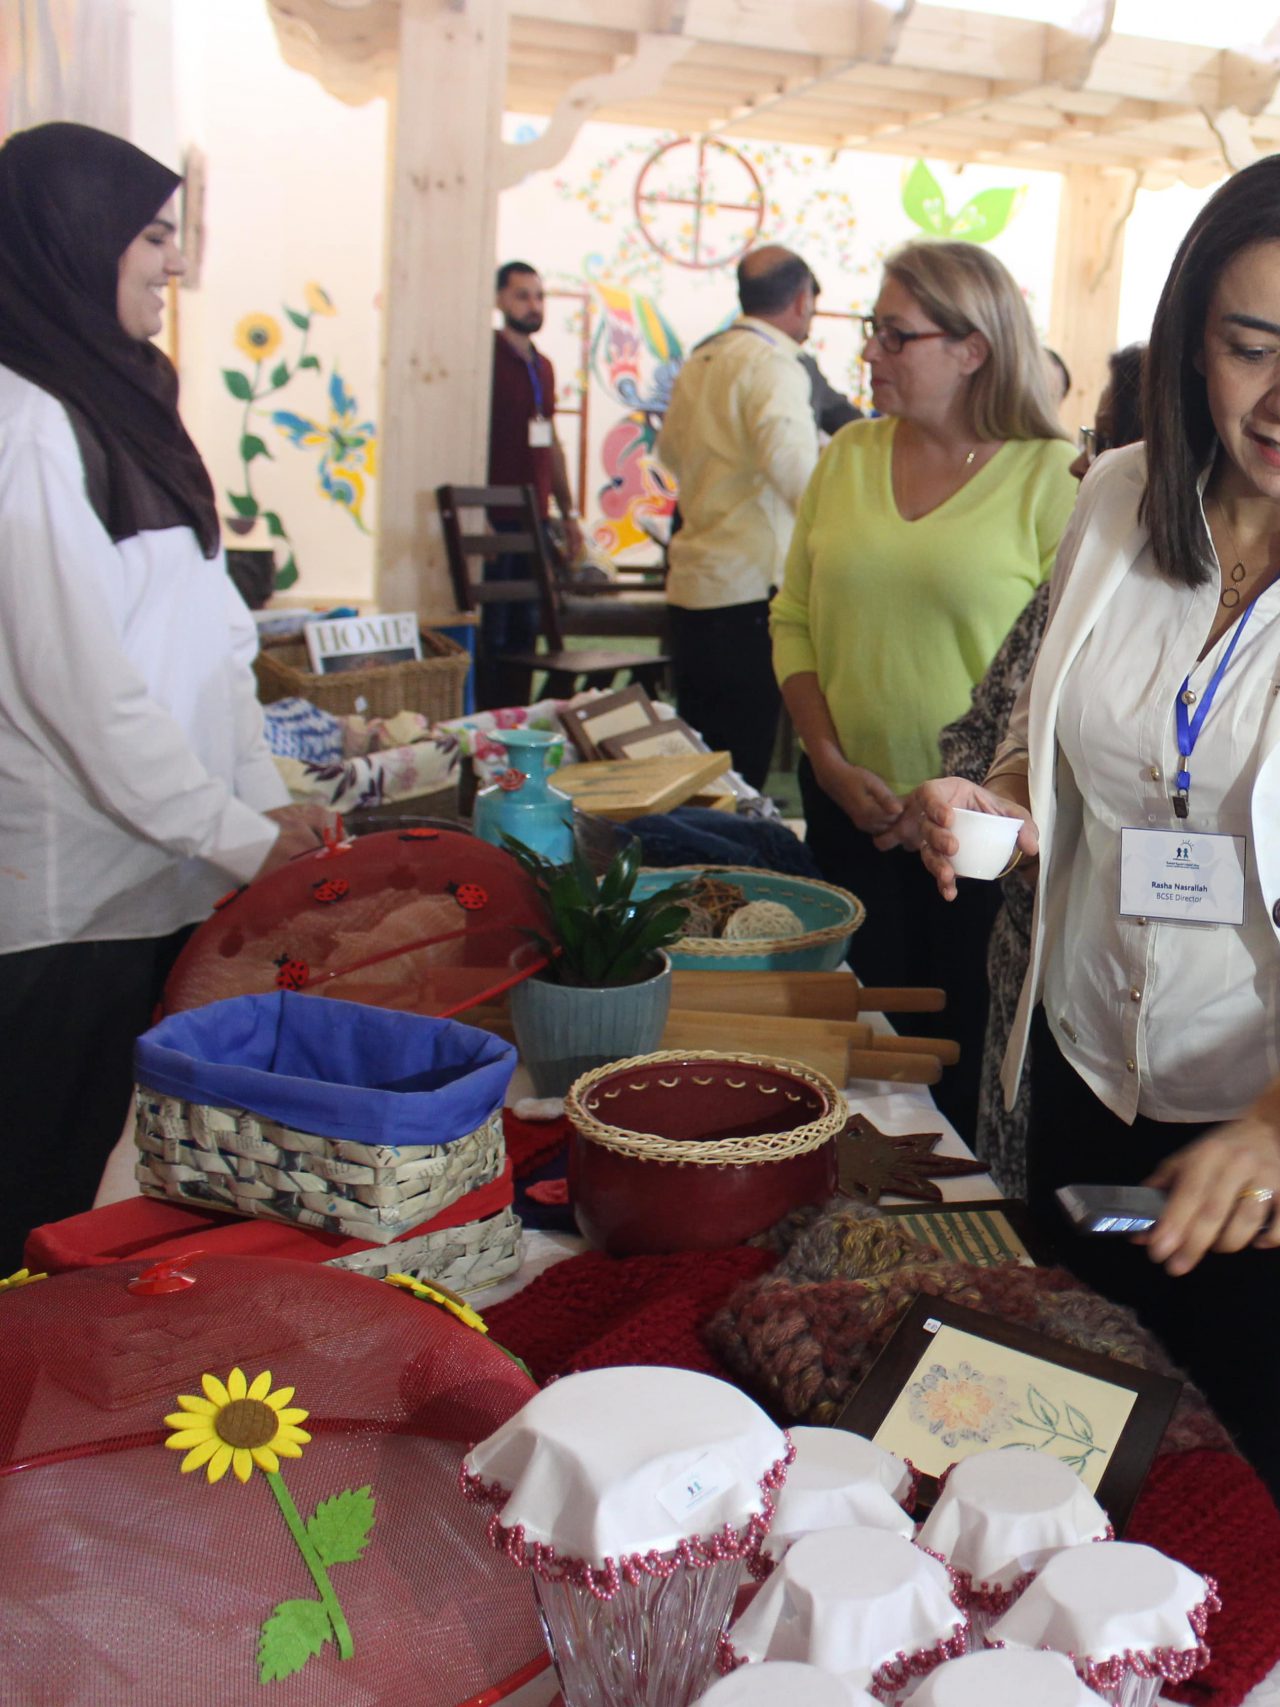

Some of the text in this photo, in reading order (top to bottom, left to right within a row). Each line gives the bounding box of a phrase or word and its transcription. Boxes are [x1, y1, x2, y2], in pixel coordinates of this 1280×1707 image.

[316, 617, 414, 652] HOME
[1151, 881, 1208, 893] Rasha Nasrallah
[1156, 892, 1202, 903] BCSE Director
